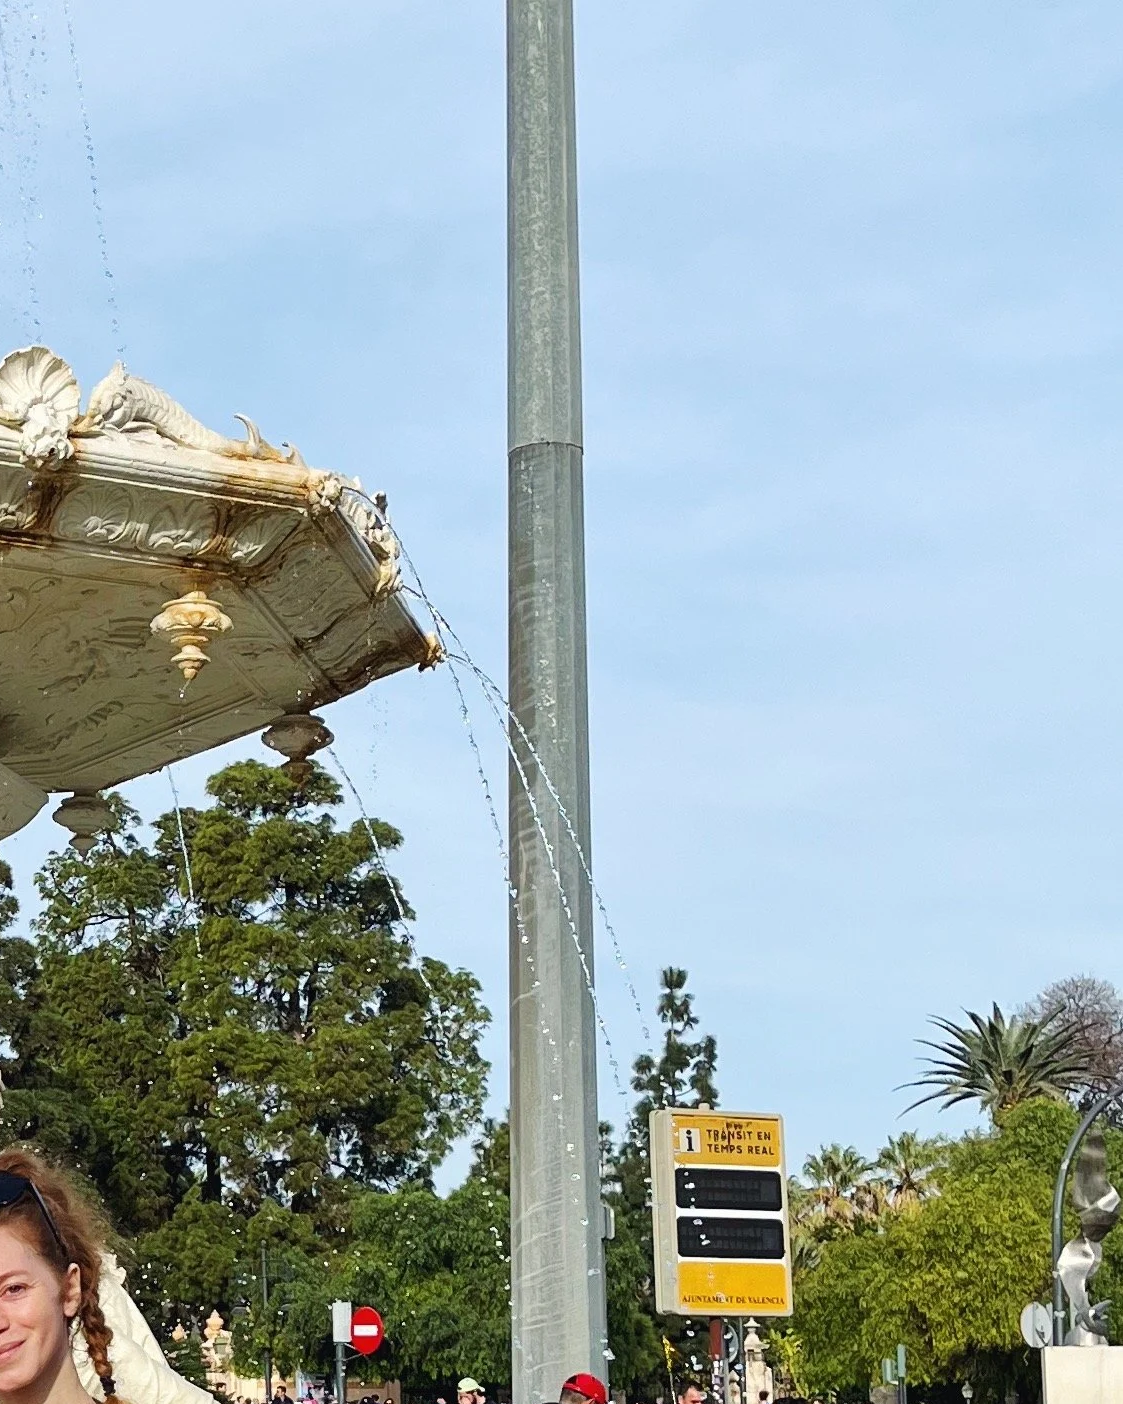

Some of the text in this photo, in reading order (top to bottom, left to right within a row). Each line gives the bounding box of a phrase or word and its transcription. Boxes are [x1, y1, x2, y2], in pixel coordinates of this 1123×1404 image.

[757, 1131, 771, 1141] EN
[707, 1143, 775, 1156] TEMPS REAL
[736, 1296, 746, 1304] DE
